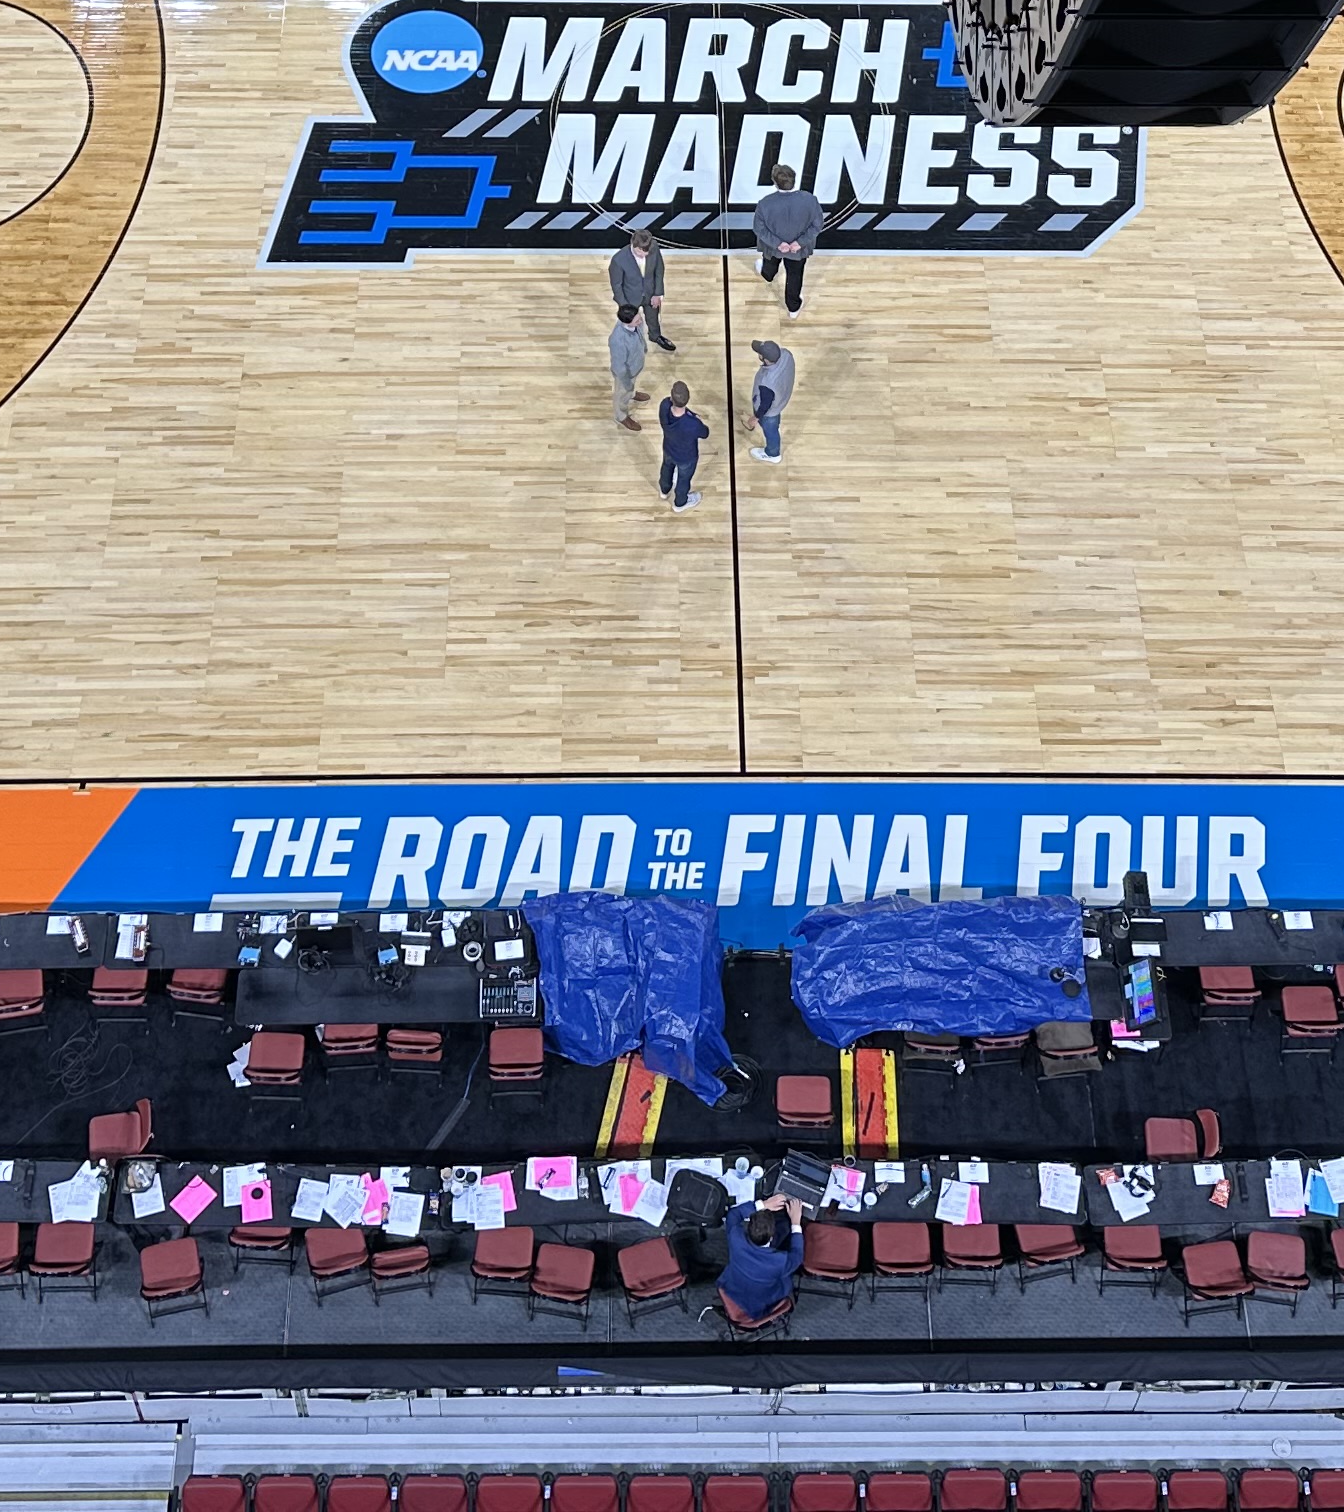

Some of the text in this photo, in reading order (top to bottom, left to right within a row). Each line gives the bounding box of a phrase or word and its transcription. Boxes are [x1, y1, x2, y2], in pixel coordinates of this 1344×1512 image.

[382, 50, 477, 71] NCAA
[487, 16, 907, 103] MARCH
[537, 113, 1120, 206] MADNESS
[230, 815, 637, 910] THE ROAD
[647, 828, 706, 890] TO THE
[716, 814, 1269, 907] FINAL FOUR
